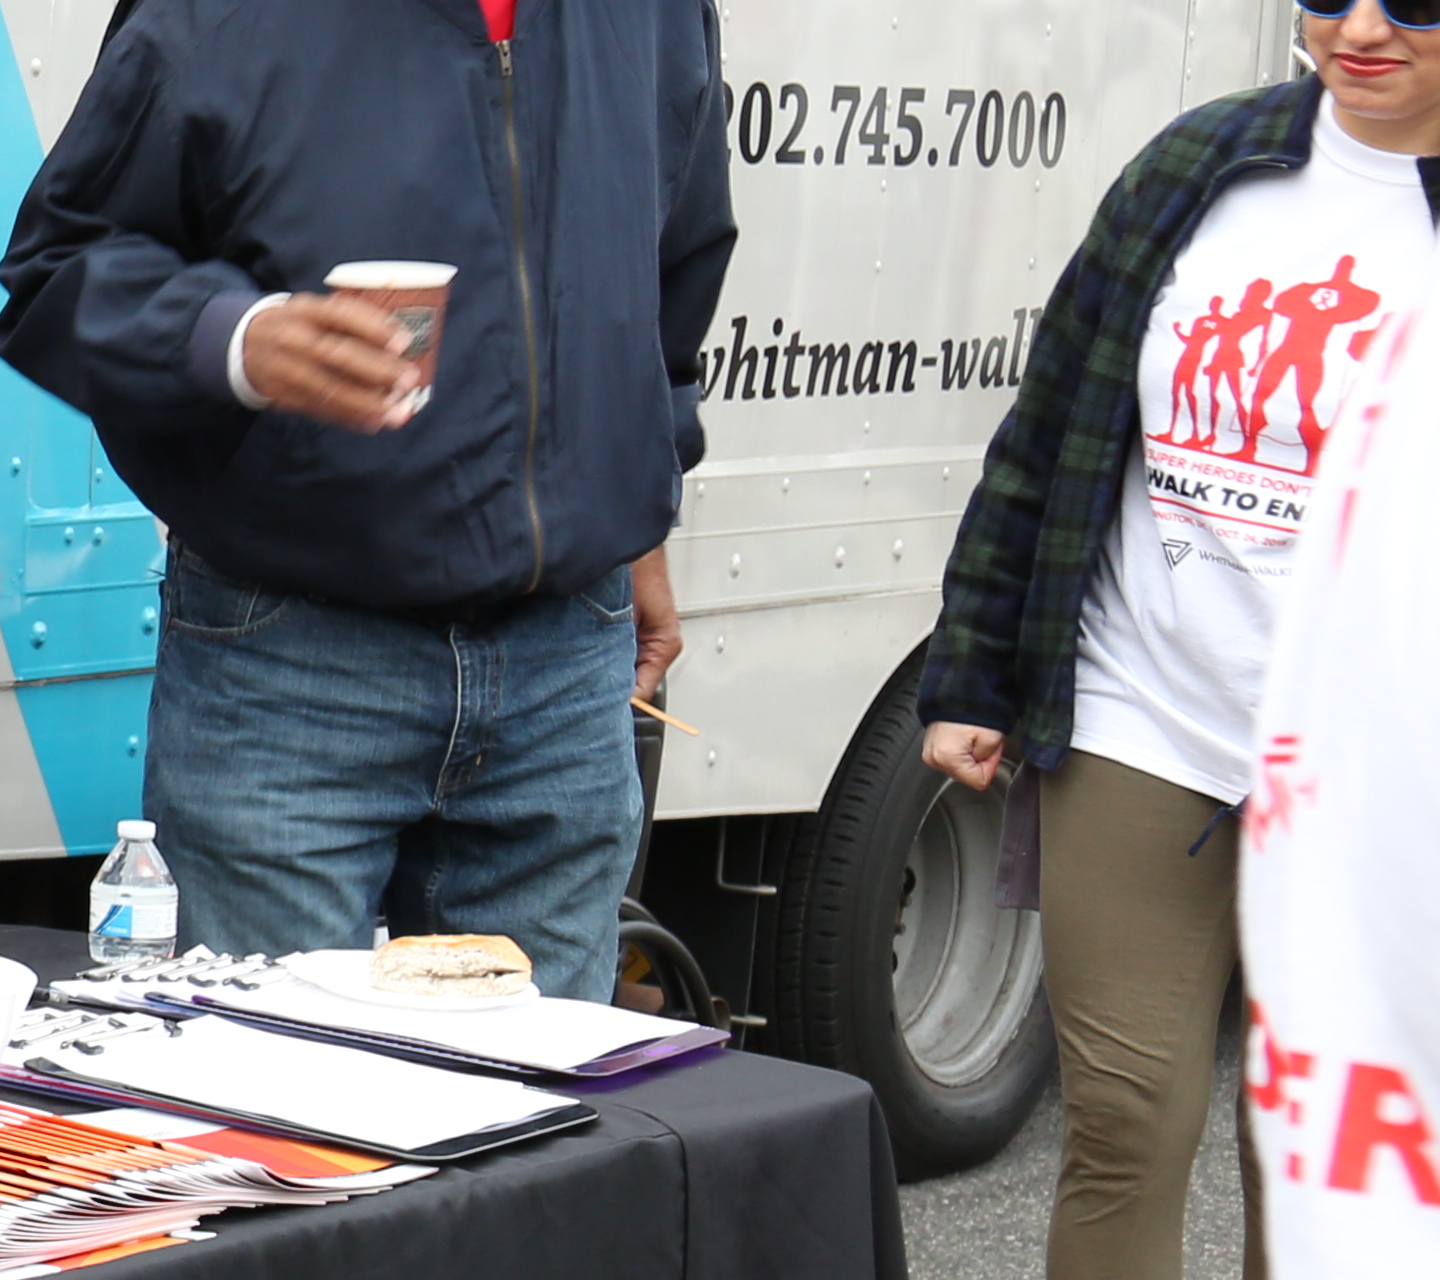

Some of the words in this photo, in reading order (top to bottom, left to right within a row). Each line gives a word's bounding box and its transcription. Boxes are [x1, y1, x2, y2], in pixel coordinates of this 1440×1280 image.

[723, 81, 1066, 168] 02.745.7000
[1147, 448, 1187, 469] SUPER
[1191, 461, 1256, 485] HEROES
[1260, 477, 1315, 497] DON'T
[1147, 467, 1213, 501] WALK
[1222, 488, 1258, 510] TO
